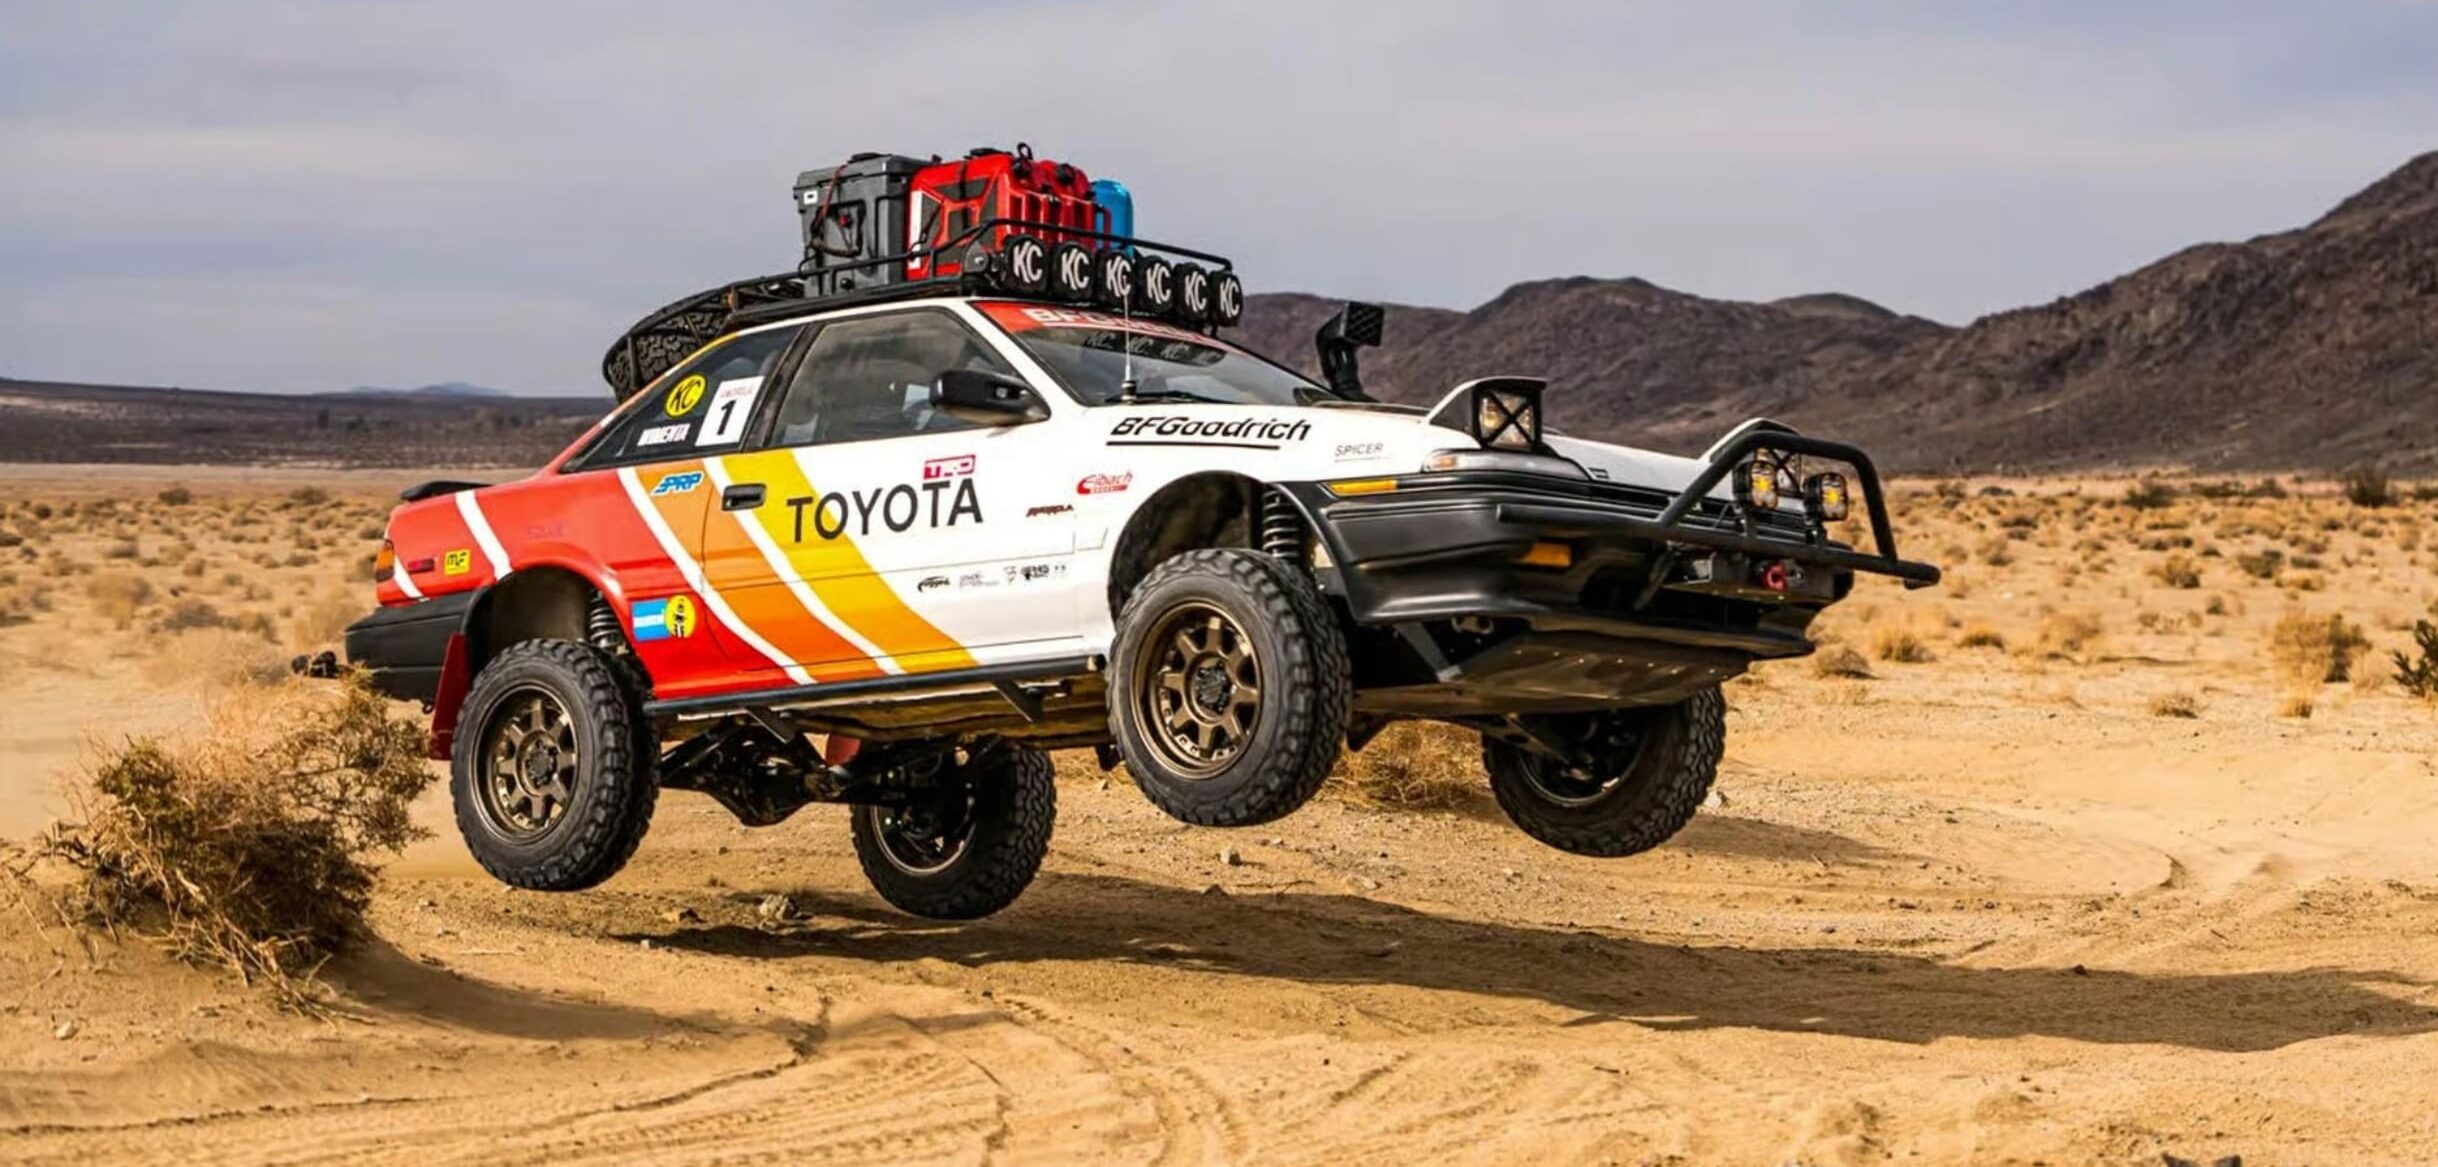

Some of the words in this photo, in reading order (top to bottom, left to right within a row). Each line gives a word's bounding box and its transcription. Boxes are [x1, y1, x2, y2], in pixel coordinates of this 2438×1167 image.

[1013, 241, 1042, 283] KC
[1061, 248, 1089, 291] KC
[1106, 256, 1132, 298] KC
[1146, 263, 1171, 304] KC
[1184, 271, 1207, 312] KC
[1220, 277, 1240, 318] KC
[669, 379, 702, 413] KC
[717, 400, 737, 436] 1
[1110, 416, 1312, 441] BFGoodrich
[1334, 442, 1384, 457] SPICER
[786, 477, 984, 543] TOYOTA
